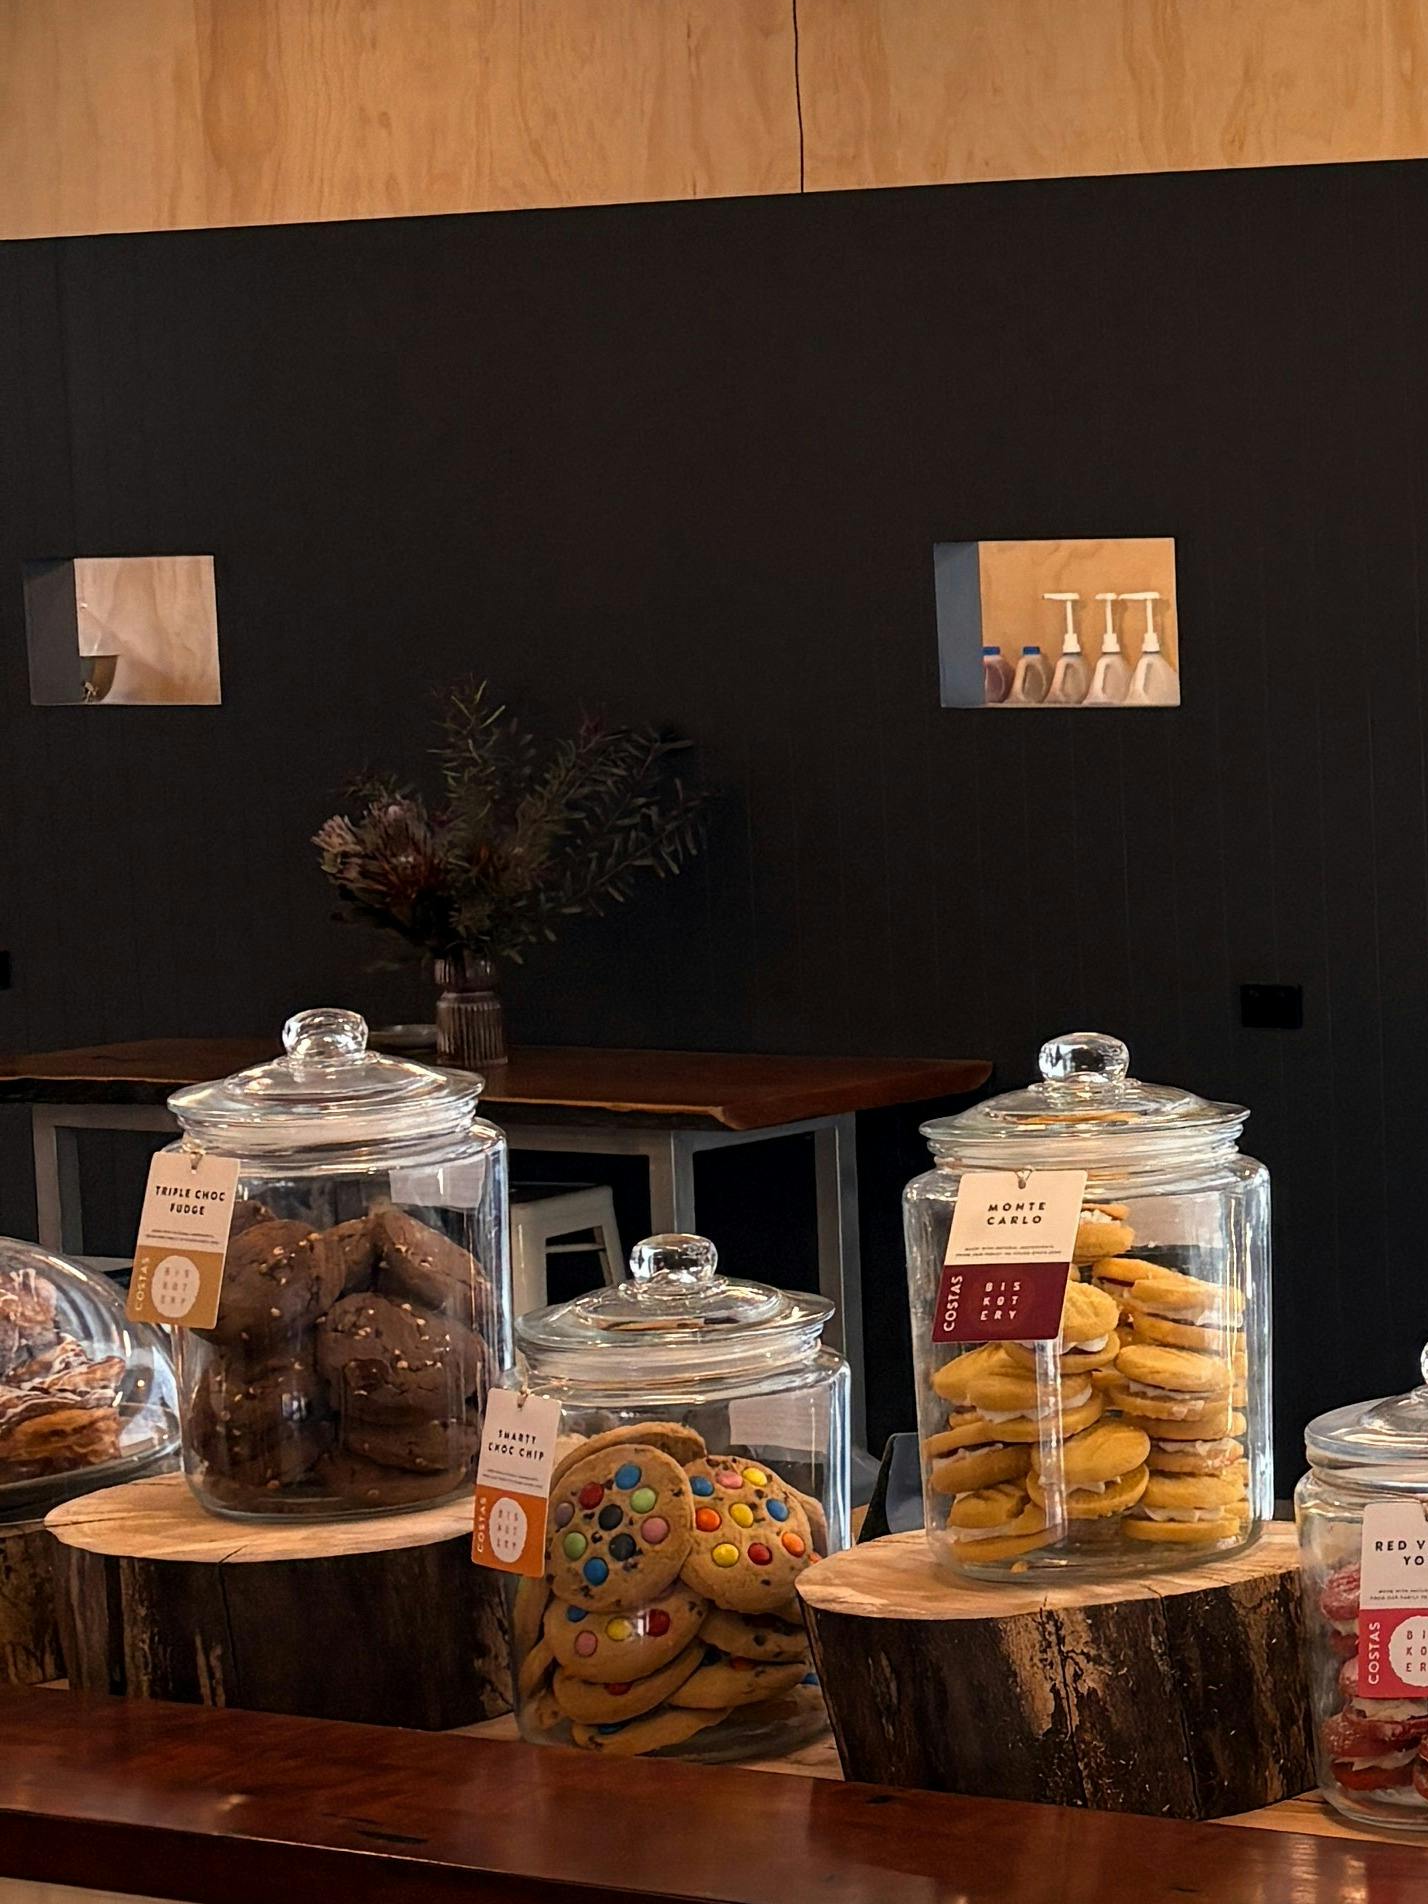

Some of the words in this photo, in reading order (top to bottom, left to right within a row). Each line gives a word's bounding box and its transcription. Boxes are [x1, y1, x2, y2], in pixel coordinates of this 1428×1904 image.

[155, 1186, 191, 1198] TRIPLE
[195, 1190, 226, 1202] CHOC
[169, 1203, 205, 1216] FUDGE
[988, 1202, 1047, 1212] MONTE
[987, 1215, 1042, 1225] CARLO
[943, 1275, 963, 1332] COSTAS
[498, 1429, 537, 1445] SMARTY
[488, 1442, 515, 1456] CHOC
[519, 1447, 545, 1461] CHIP
[1375, 1540, 1408, 1552] RED
[1368, 1621, 1381, 1685] COSTAS
